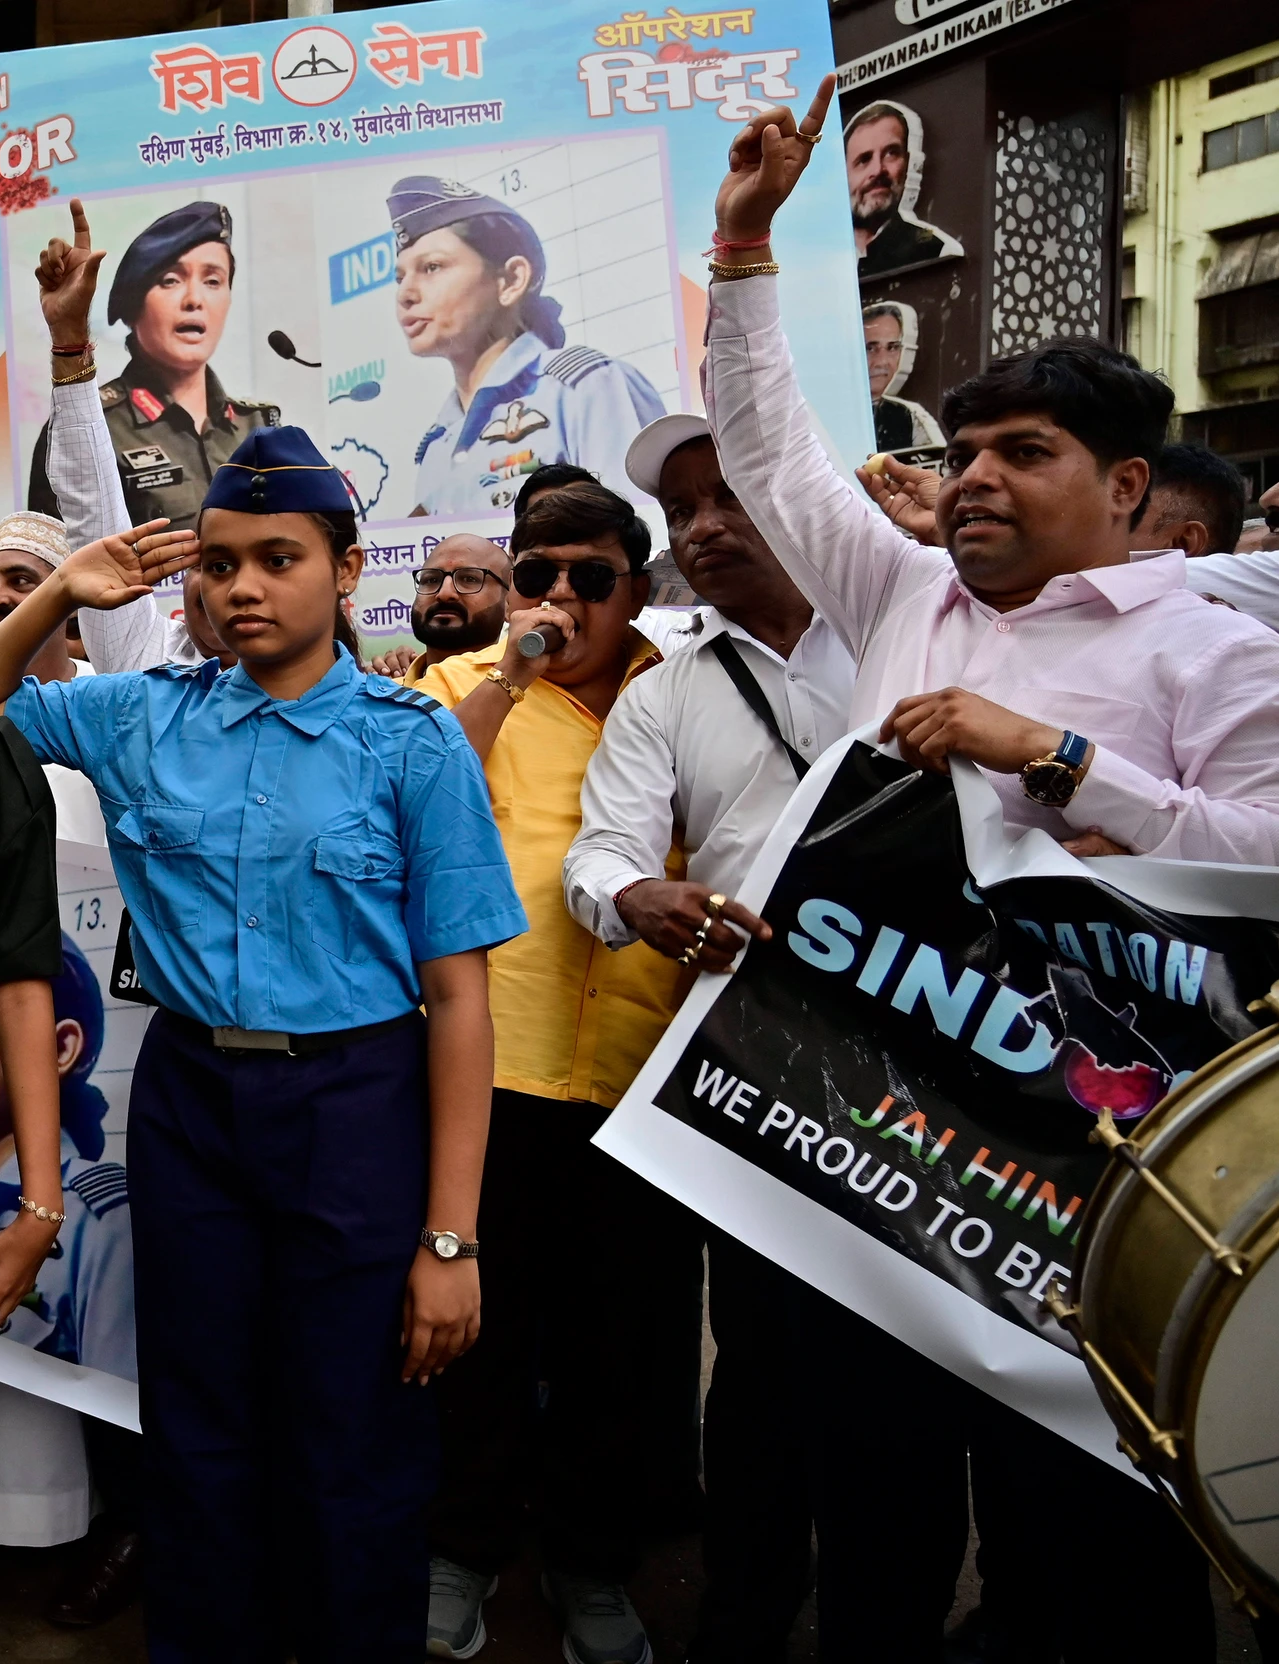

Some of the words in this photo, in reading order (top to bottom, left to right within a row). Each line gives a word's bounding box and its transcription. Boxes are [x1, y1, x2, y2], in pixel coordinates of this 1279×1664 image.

[595, 9, 754, 47] ऑपरेशन
[944, 7, 1003, 45] NIKAM
[154, 47, 262, 111] शिव
[368, 26, 483, 86] सेना
[140, 135, 186, 165] दक्षिण
[234, 124, 284, 152] विभाग
[352, 104, 412, 143] मुंबादेवी
[415, 101, 503, 130] विधानसभा
[74, 897, 107, 932] 13.
[693, 1059, 761, 1125] WE
[757, 1099, 918, 1212] PROUD
[926, 1195, 994, 1259] TO
[994, 1241, 1072, 1303] BE
[849, 1094, 956, 1166] JAI
[959, 1147, 1082, 1246] HIN
